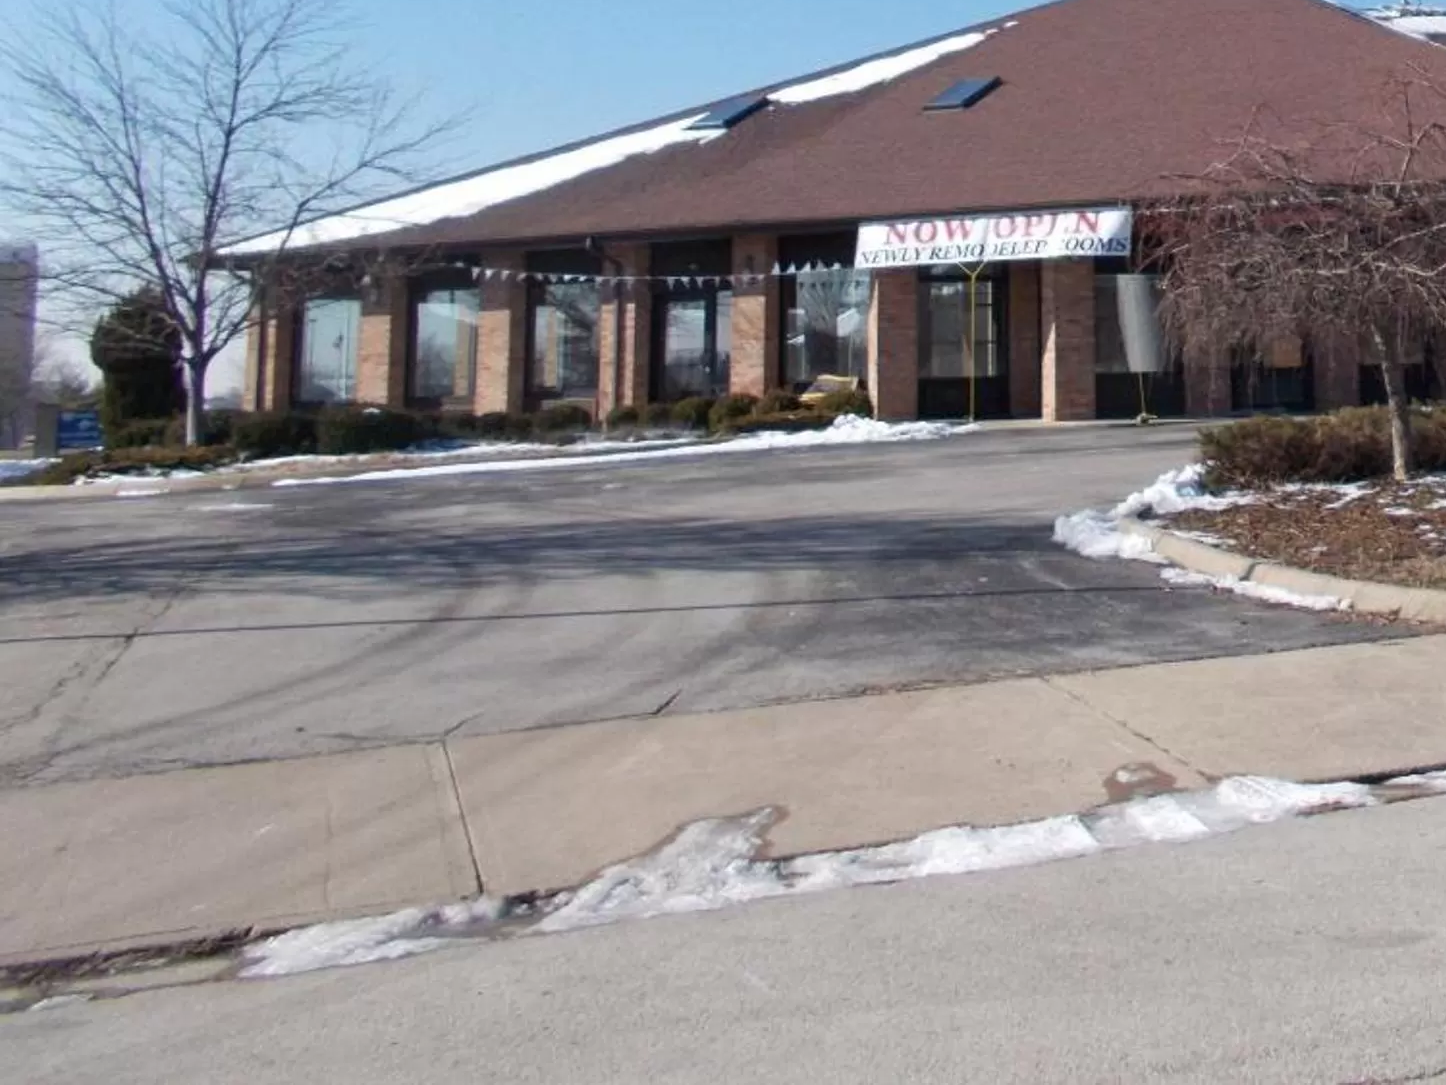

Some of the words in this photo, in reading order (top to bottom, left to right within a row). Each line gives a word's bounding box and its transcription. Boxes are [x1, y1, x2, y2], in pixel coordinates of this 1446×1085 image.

[883, 219, 974, 245] NOW
[860, 246, 924, 265] NEWLY
[1057, 235, 1129, 255] OOMS
